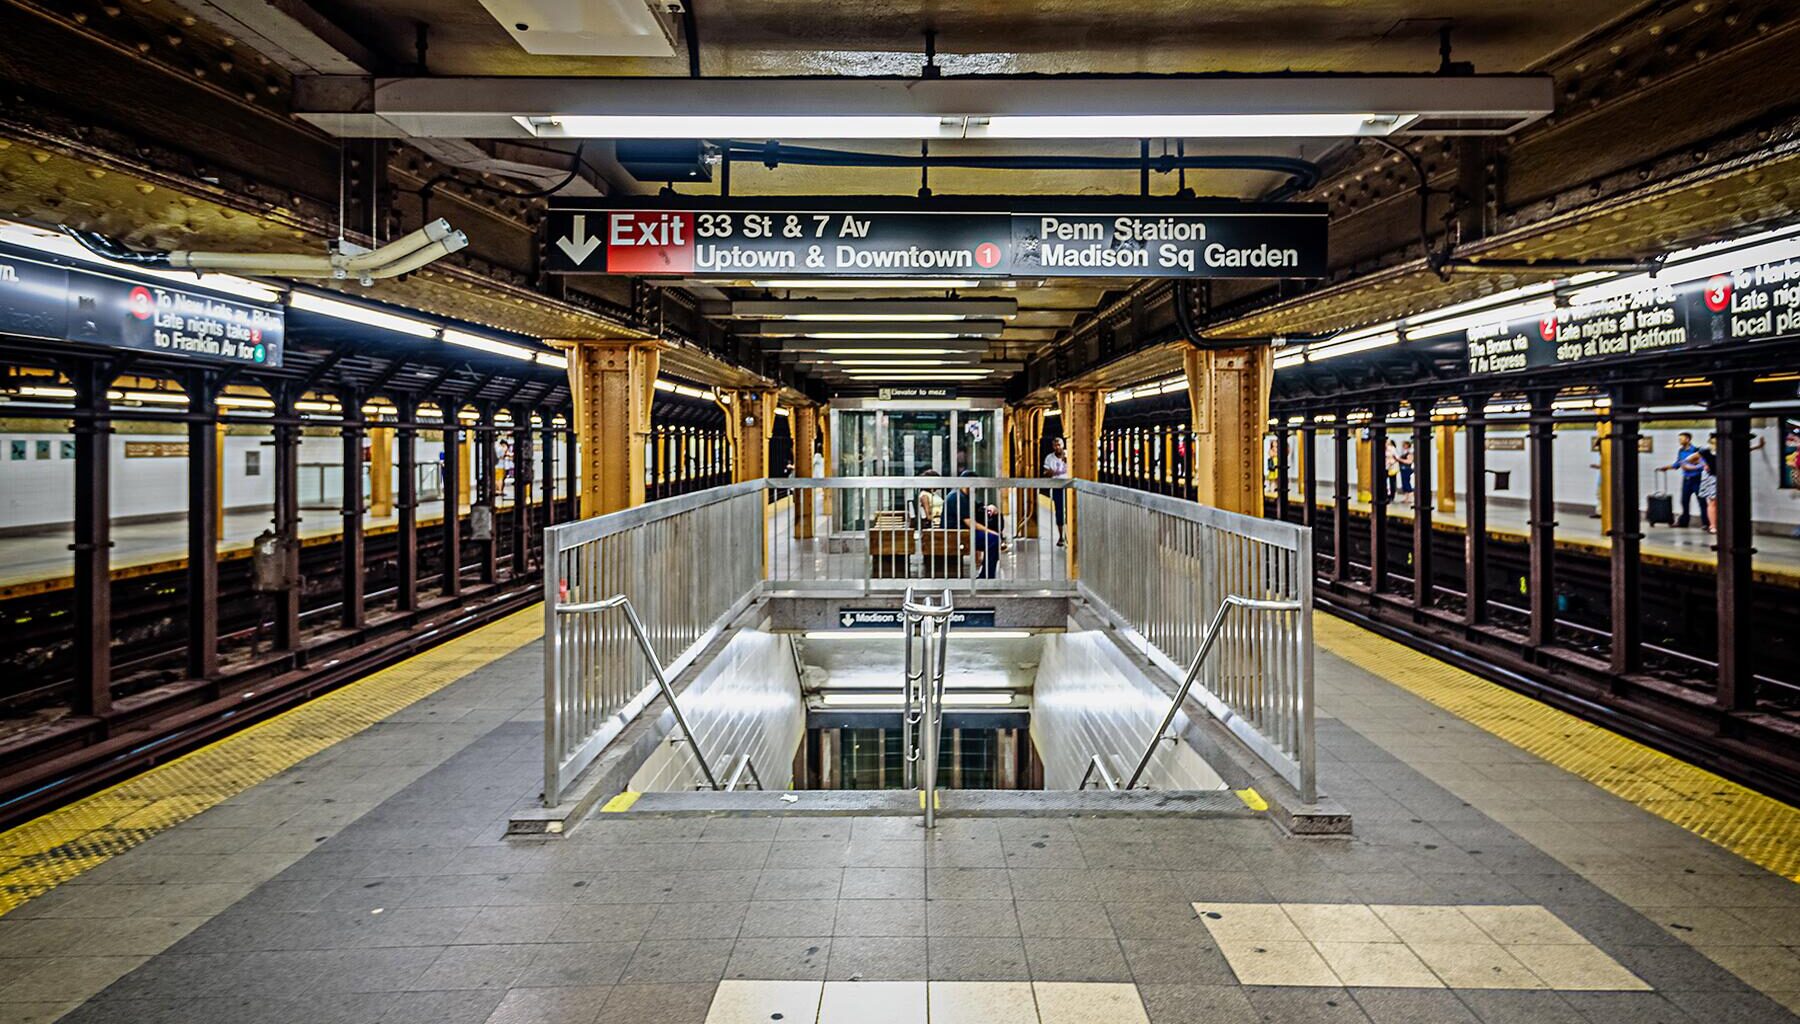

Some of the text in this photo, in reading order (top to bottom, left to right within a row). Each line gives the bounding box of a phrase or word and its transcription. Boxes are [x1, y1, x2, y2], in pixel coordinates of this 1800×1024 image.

[610, 214, 685, 246] Exit
[697, 215, 871, 238] 33 St & 7 Av
[1041, 217, 1207, 241] Penn Station
[696, 245, 796, 271] Uptown
[806, 245, 825, 268] &
[836, 246, 973, 268] Downtown
[1041, 243, 1298, 271] Madison Sq Garden
[1730, 269, 1752, 290] To
[154, 289, 171, 309] To
[175, 293, 204, 314] New
[1731, 282, 1800, 313] Late nig
[154, 310, 185, 330] Late
[187, 316, 224, 338] nights
[226, 322, 251, 341] take
[1556, 307, 1675, 342] Late nights all trains
[1731, 310, 1772, 337] local
[154, 329, 170, 348] to
[173, 331, 220, 354] Franklin
[221, 339, 237, 357] Av
[238, 342, 255, 360] for
[1469, 333, 1528, 358] The Bronx via
[1557, 326, 1686, 361] stop at local platform
[1469, 357, 1478, 374] 7
[1489, 353, 1527, 372] Express
[856, 612, 894, 622] Madison
